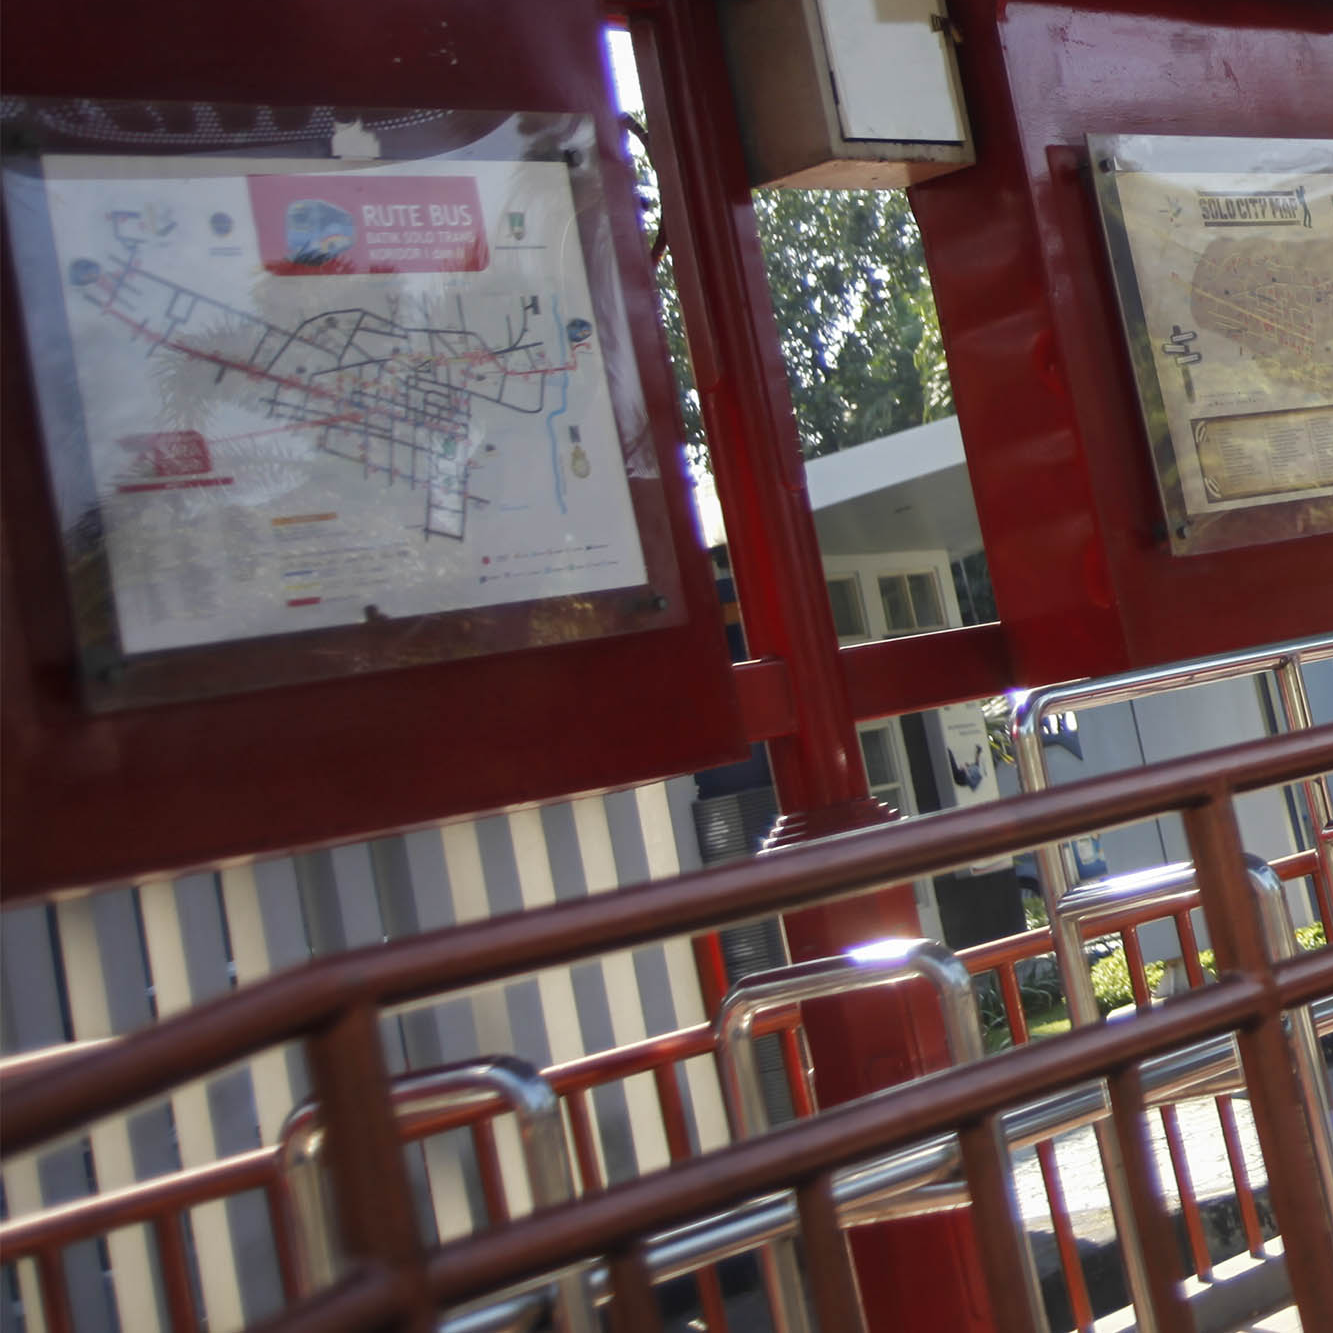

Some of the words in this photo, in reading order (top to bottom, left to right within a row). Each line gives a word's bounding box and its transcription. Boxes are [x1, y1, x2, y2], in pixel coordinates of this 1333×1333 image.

[363, 204, 424, 227] RUTE
[428, 204, 473, 226] BUS
[1199, 196, 1236, 220] SOLO
[1236, 196, 1267, 219] CITY
[1268, 196, 1298, 219] MAP
